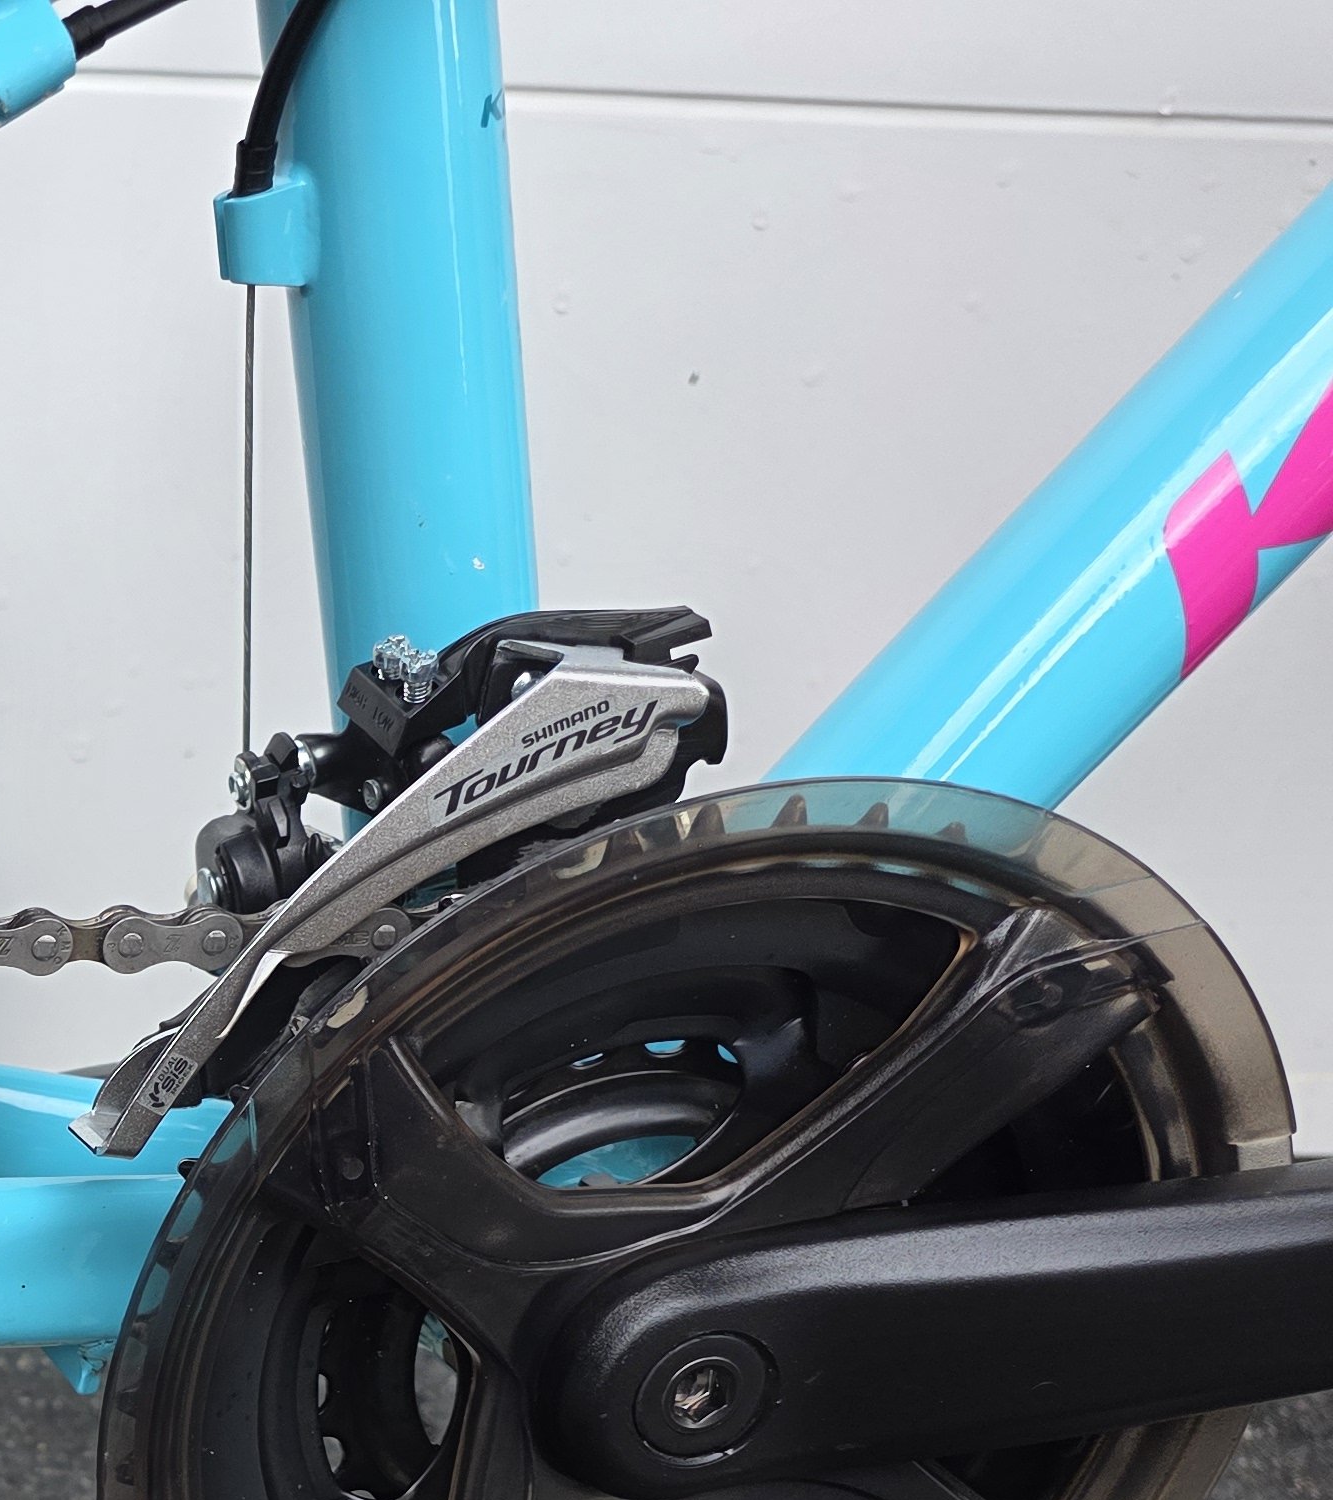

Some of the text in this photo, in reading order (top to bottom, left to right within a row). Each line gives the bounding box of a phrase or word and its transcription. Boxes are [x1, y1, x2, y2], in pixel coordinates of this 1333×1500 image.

[522, 699, 611, 749] SHIMANO
[434, 699, 659, 818] Tourney
[157, 1056, 180, 1082] DUAL
